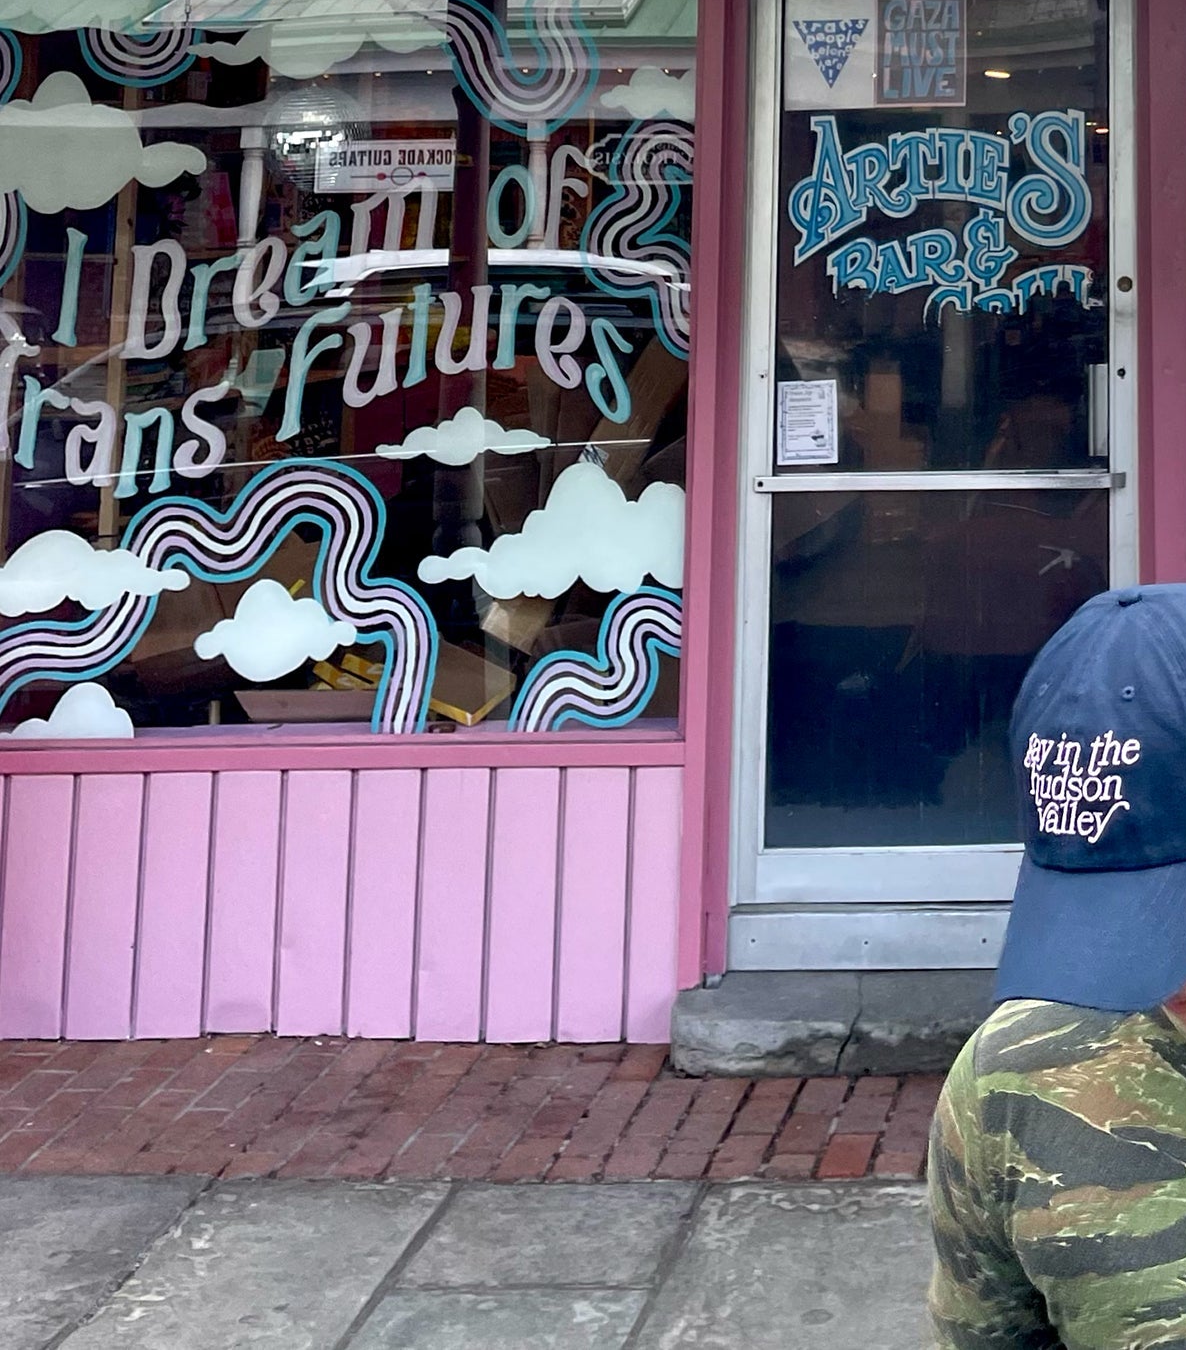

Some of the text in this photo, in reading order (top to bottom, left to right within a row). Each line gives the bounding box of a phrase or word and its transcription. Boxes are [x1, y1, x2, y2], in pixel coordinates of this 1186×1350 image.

[798, 18, 866, 34] trans
[806, 30, 861, 47] people
[884, 31, 960, 66] MUST
[883, 66, 956, 99] LIVE
[788, 109, 1092, 266] ARTIE'S
[51, 227, 88, 347] I
[119, 175, 438, 359] Dream
[826, 228, 965, 299] BAR
[963, 207, 1018, 288] &
[1053, 732, 1083, 776] in
[1088, 730, 1140, 776] the
[1030, 762, 1122, 807] hudson
[1037, 790, 1130, 844] valley
